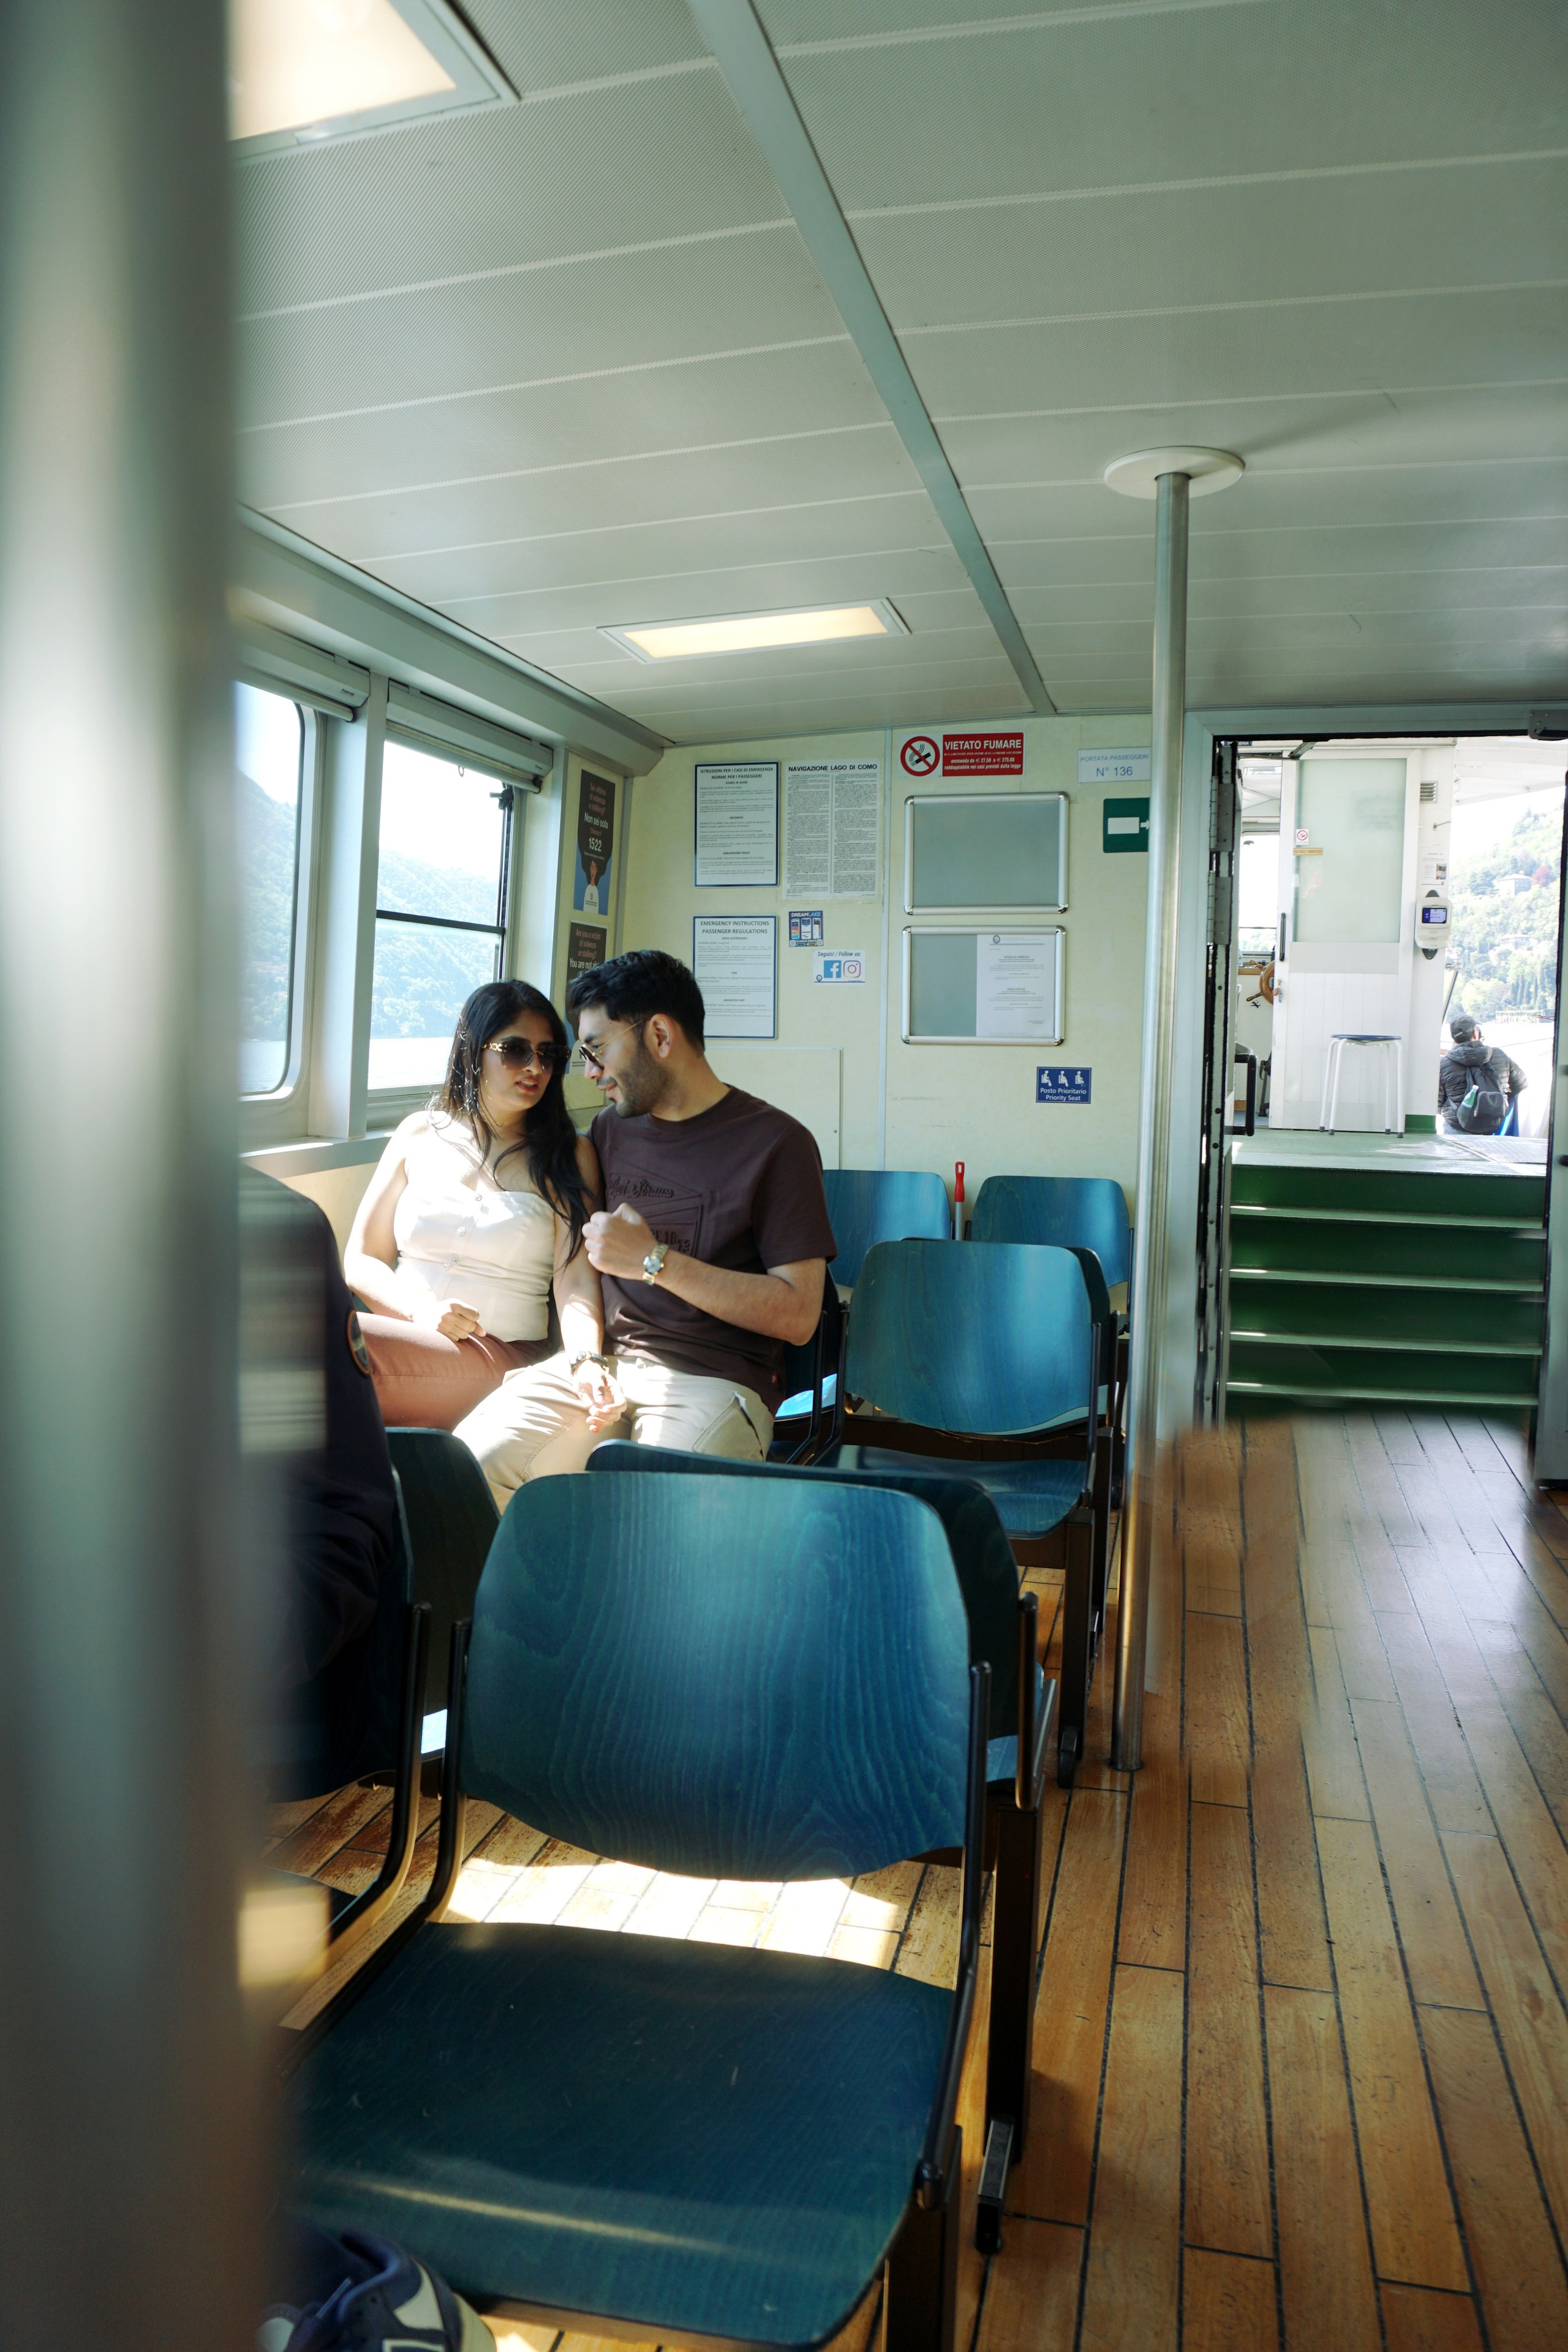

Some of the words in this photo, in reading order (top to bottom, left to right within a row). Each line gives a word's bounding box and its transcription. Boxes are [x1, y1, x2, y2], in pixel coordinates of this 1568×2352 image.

[944, 740, 981, 750] VIETATO
[984, 739, 1022, 749] FUMARE
[1096, 767, 1109, 777] N°
[1114, 766, 1133, 776] 136
[584, 812, 593, 824] Non
[589, 837, 602, 852] 1522
